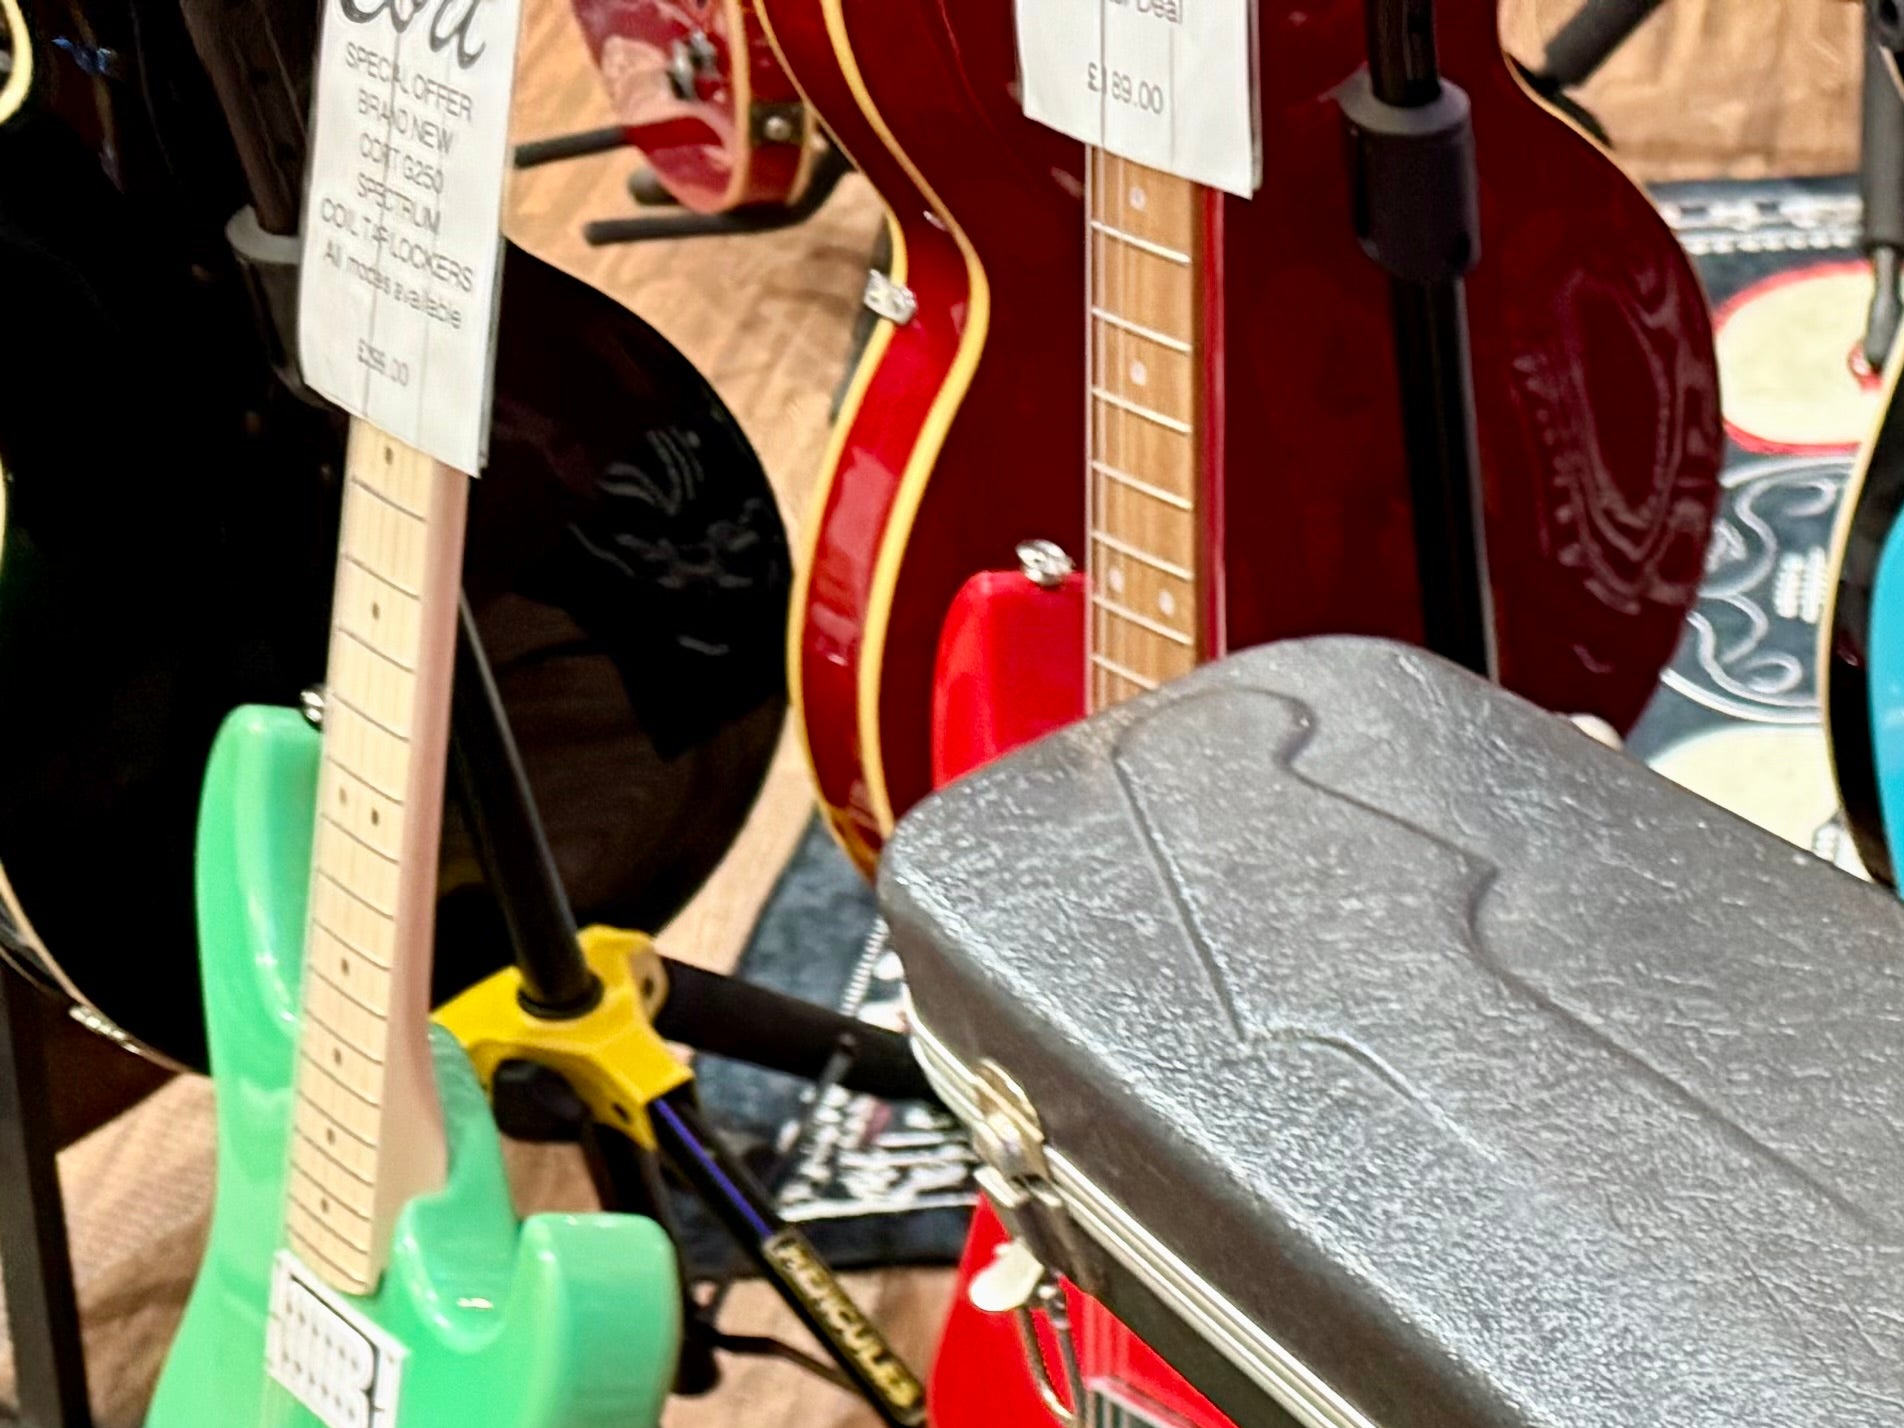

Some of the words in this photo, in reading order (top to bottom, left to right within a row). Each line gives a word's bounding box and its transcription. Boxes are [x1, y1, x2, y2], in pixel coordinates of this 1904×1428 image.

[414, 73, 473, 122] OFFER
[1087, 61, 1164, 115] £189.00
[412, 114, 453, 154] NEW
[403, 155, 443, 194] G250
